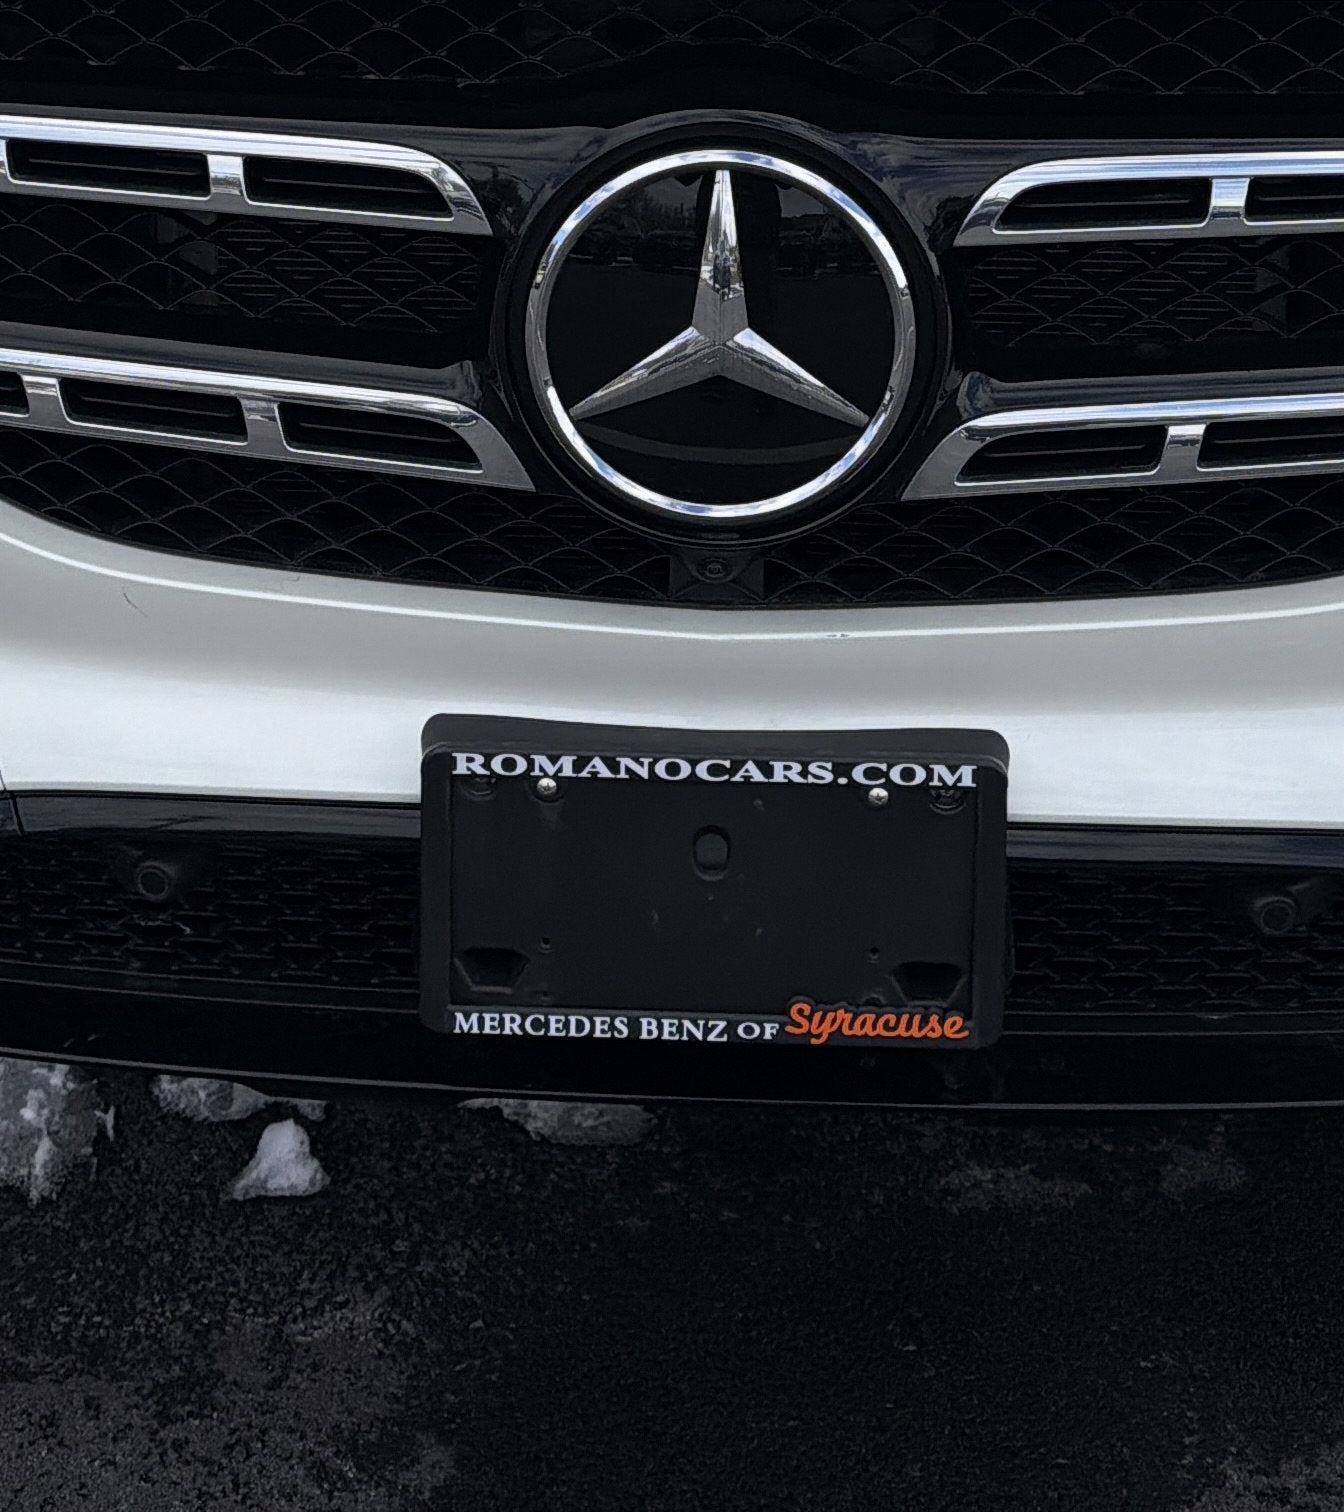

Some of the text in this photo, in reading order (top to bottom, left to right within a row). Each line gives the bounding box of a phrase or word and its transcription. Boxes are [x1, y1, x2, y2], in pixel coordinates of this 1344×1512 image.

[451, 752, 977, 788] ROMANOCARS.COM
[453, 1002, 970, 1046] MERCEDES BENZ OF Syracuse
